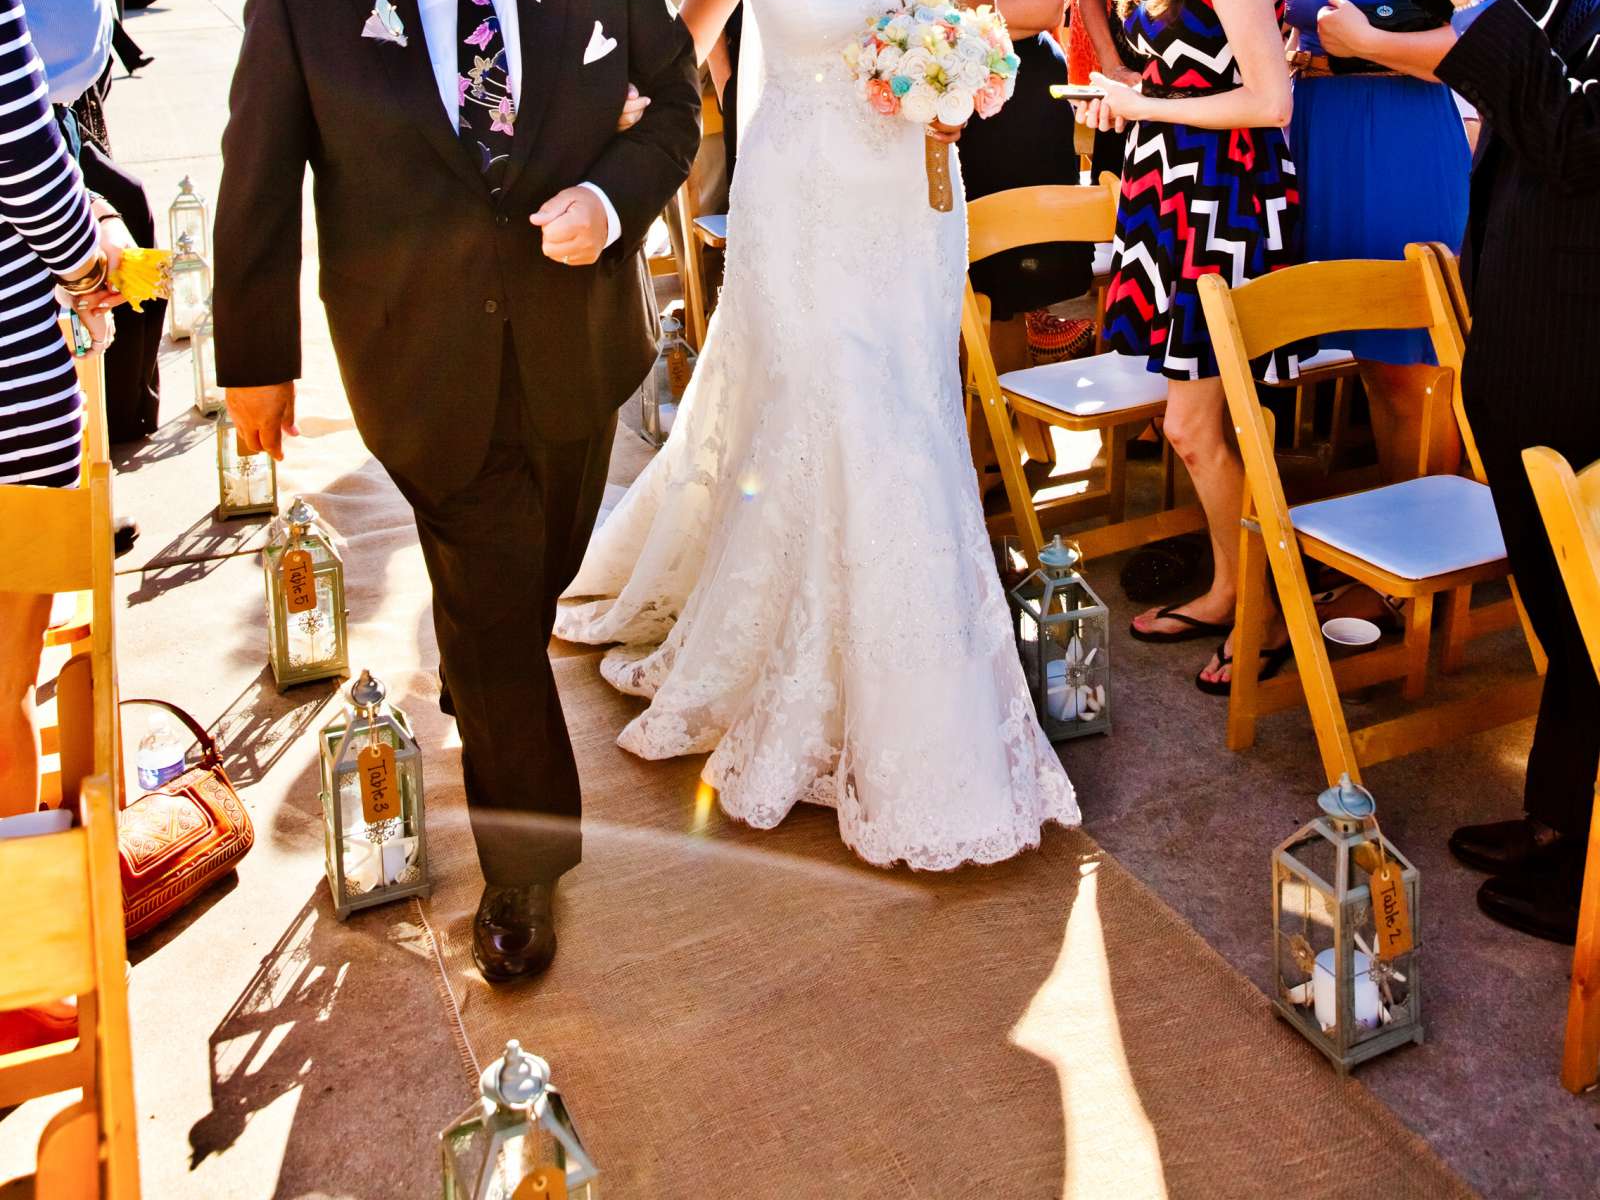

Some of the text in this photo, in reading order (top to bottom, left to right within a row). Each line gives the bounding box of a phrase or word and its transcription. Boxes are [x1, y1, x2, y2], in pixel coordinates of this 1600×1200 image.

[290, 561, 309, 605] Table 5
[368, 759, 389, 813] Table 3
[1381, 880, 1402, 945] Table 2
